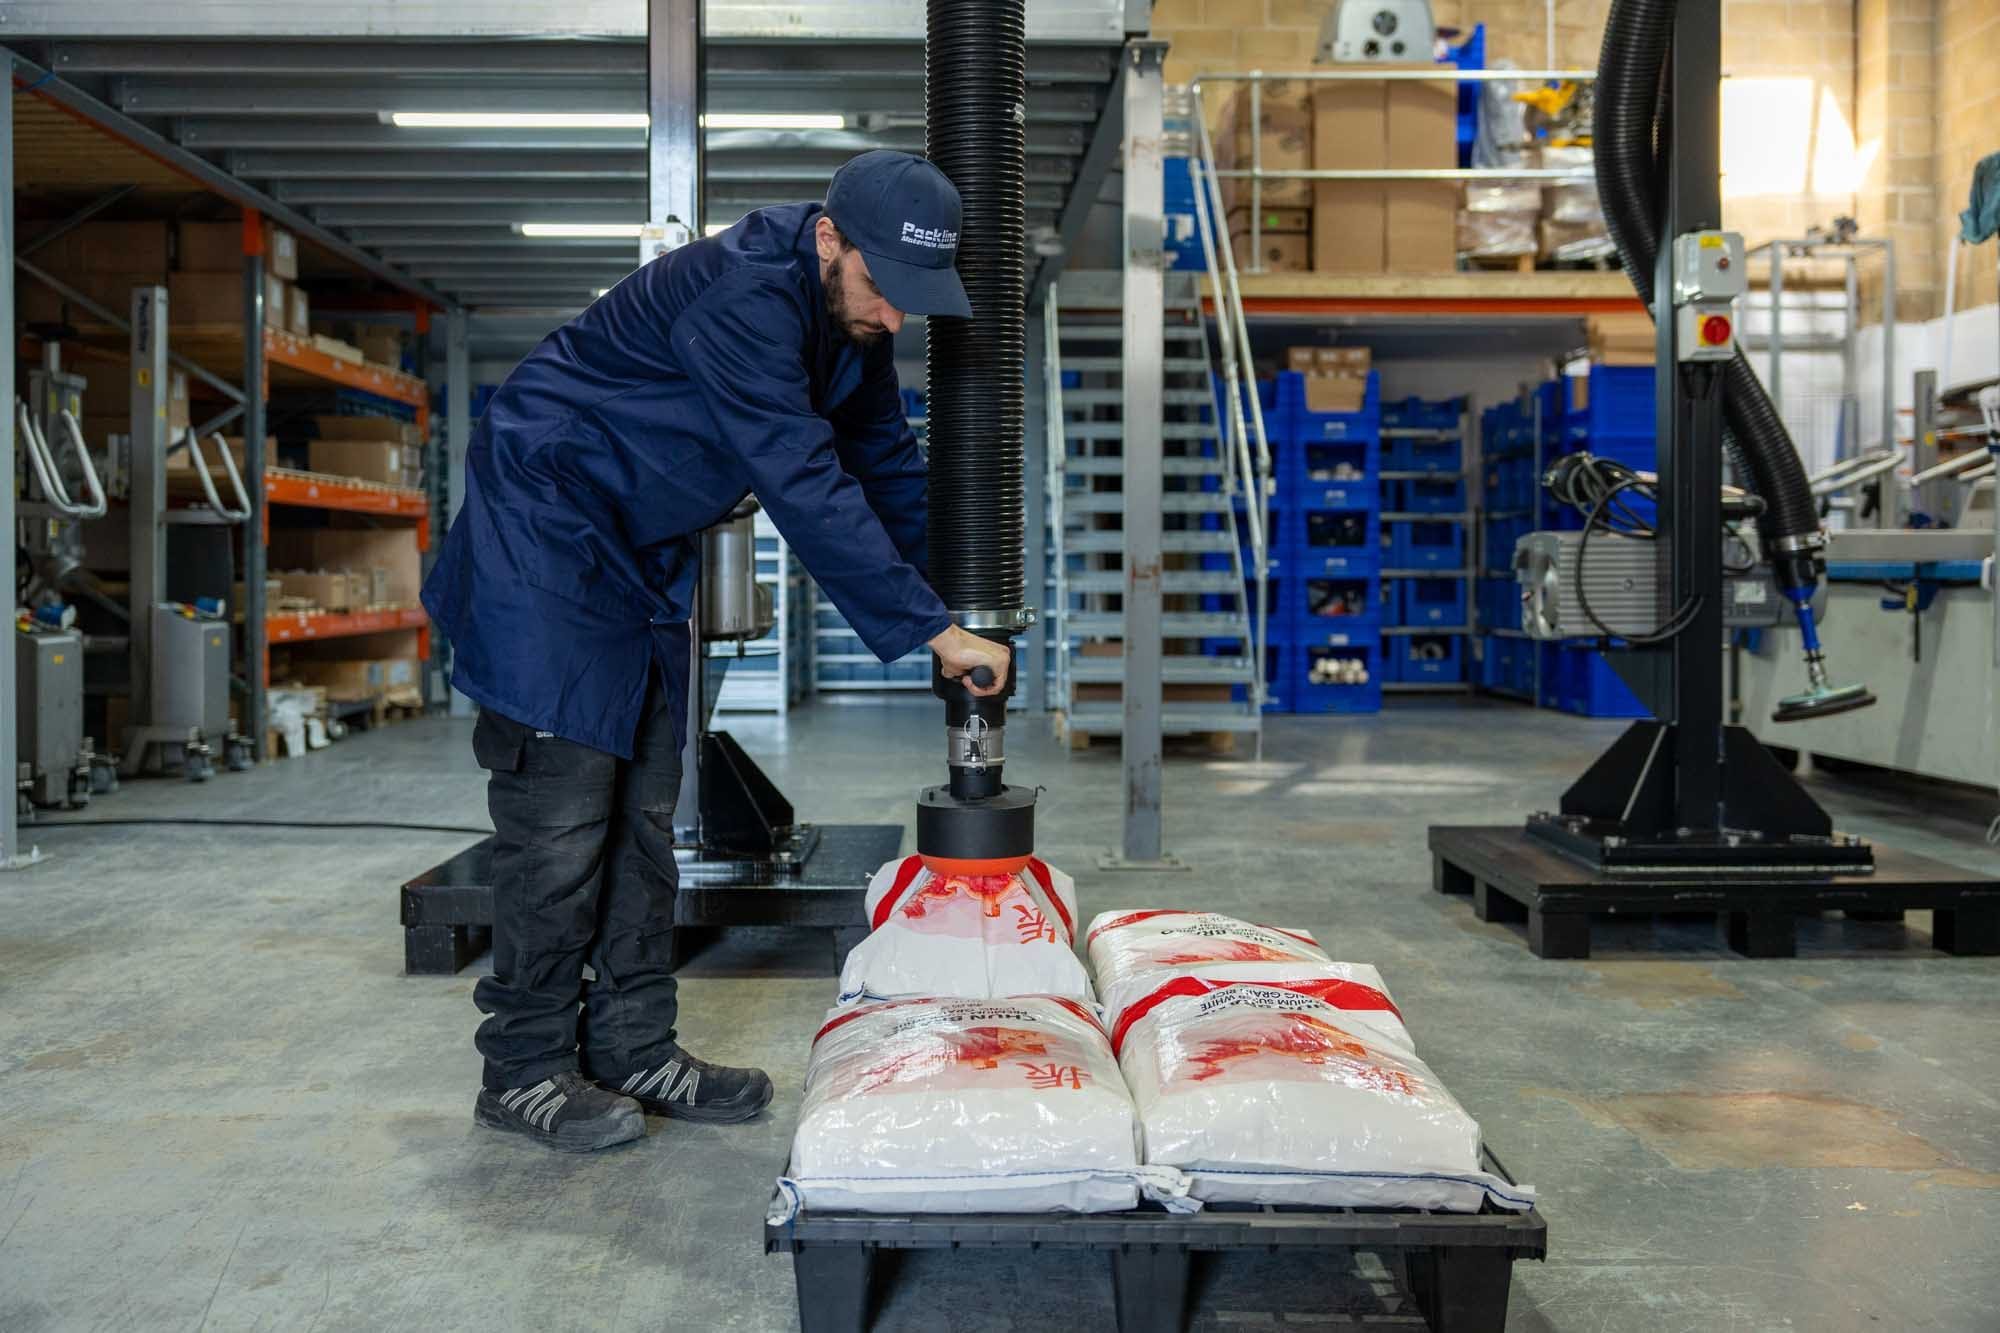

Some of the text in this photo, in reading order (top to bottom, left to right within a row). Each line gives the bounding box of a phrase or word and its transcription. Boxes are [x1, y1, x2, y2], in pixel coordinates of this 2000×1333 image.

[902, 221, 957, 243] Packline
[1200, 995, 1236, 1012] WHITE
[970, 1014, 1037, 1022] CHUN
